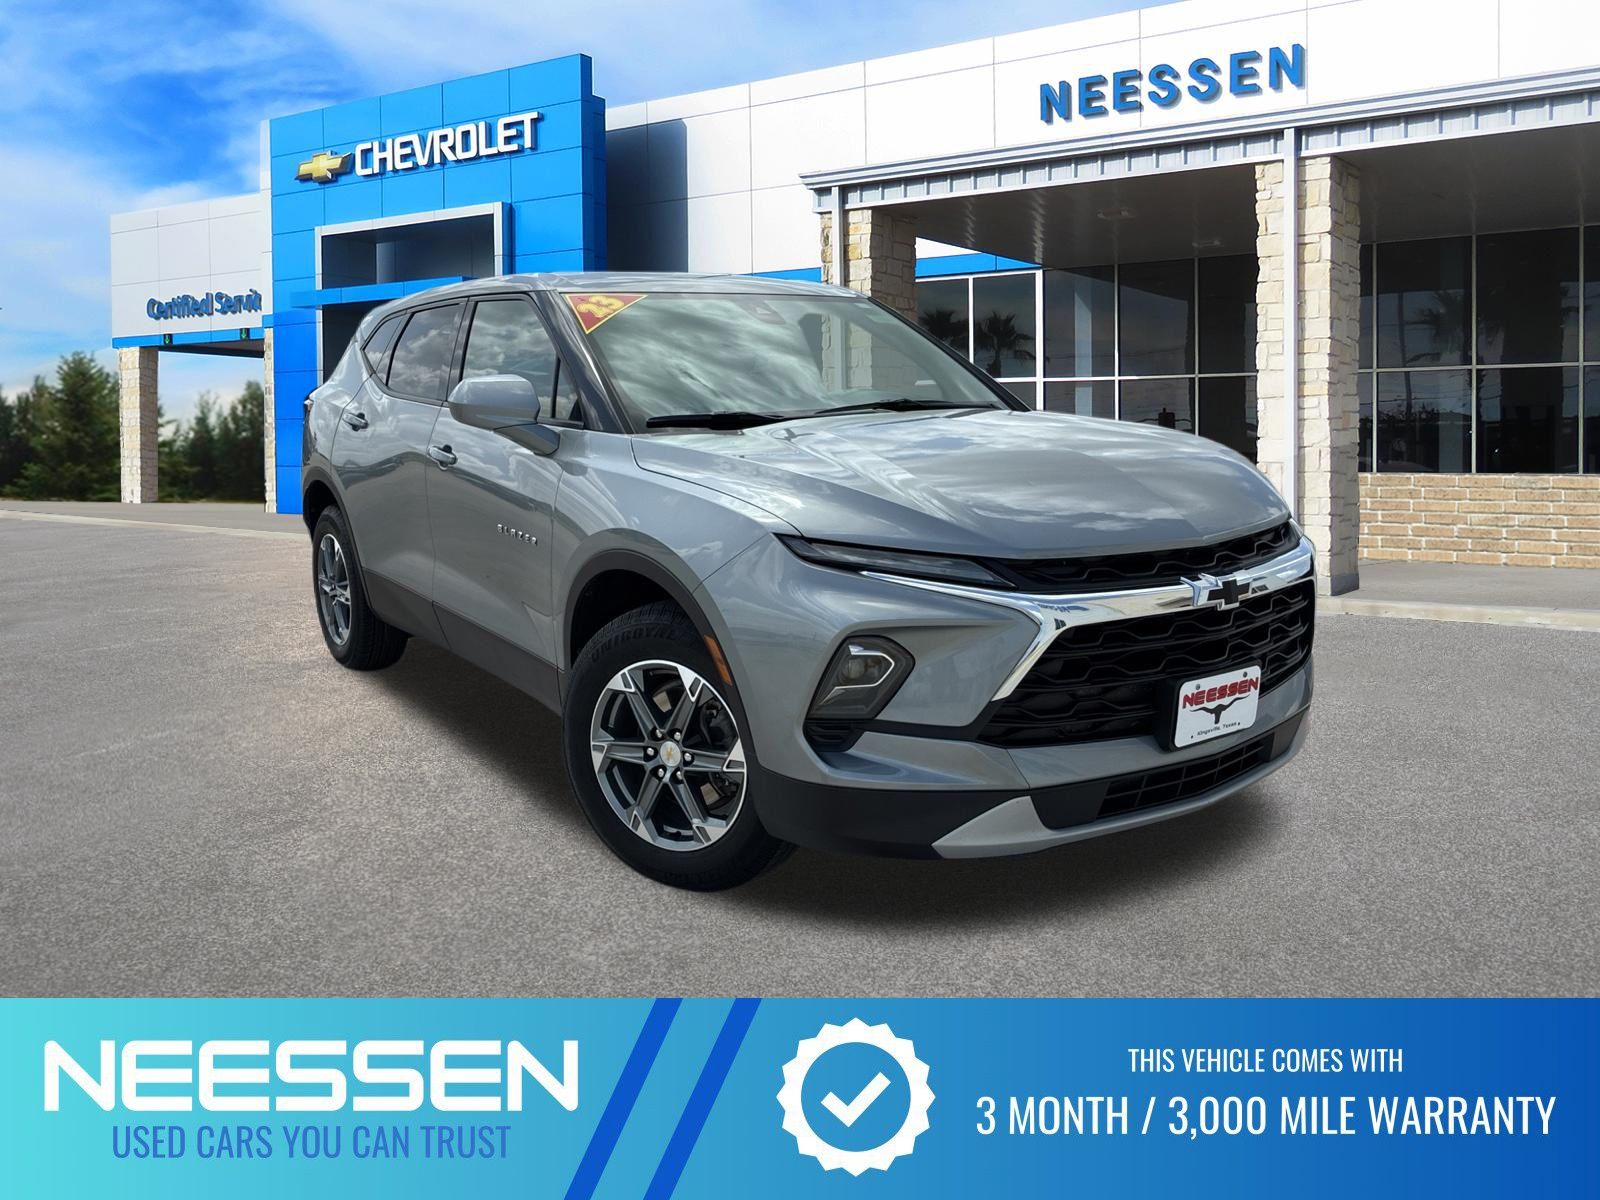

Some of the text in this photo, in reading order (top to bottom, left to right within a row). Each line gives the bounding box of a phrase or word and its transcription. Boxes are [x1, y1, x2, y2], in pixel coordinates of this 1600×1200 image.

[1040, 43, 1306, 124] NEESSEN
[354, 111, 542, 177] CHEVROLET
[147, 292, 214, 320] Certified
[497, 523, 538, 546] BLAZER
[1182, 677, 1259, 709] NEESSEN
